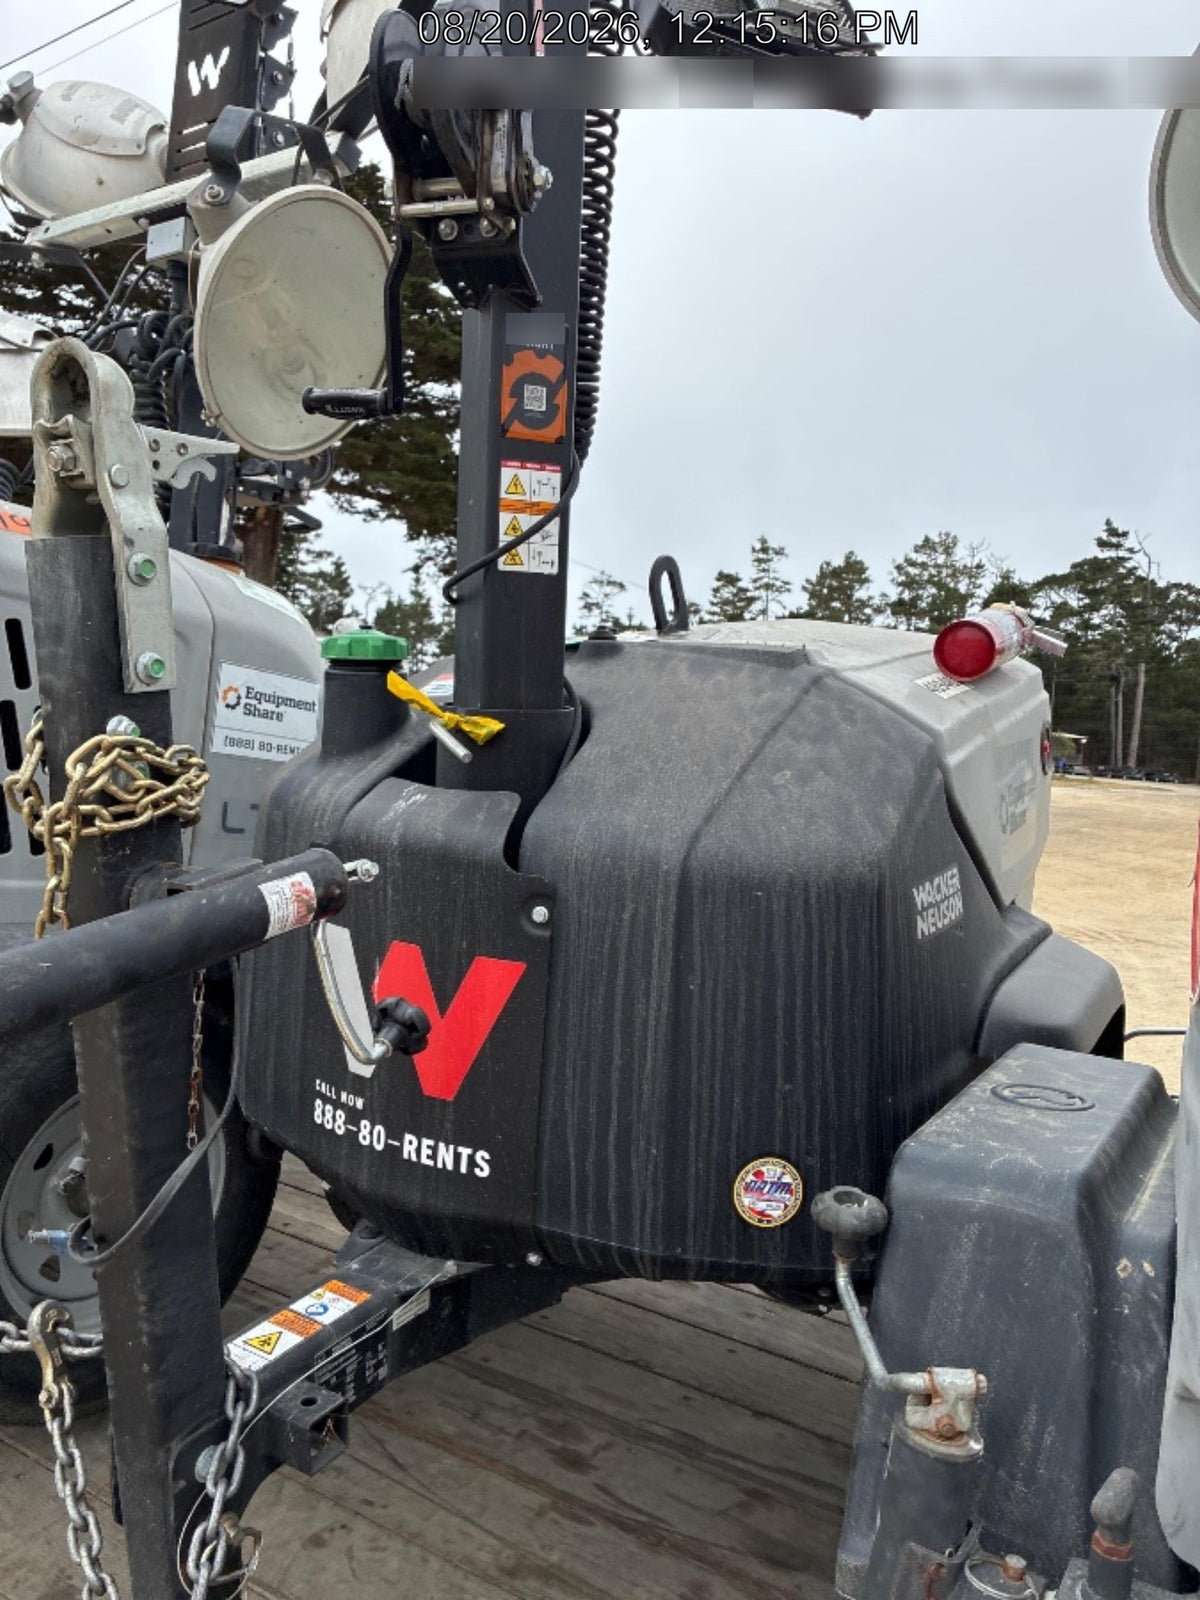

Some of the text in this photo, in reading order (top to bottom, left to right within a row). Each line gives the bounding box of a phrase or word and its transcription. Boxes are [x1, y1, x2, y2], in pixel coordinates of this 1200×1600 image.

[242, 702, 284, 723] Share
[244, 685, 317, 713] Equipment
[258, 740, 304, 756] 80-RENT
[912, 867, 961, 911] WACKER
[917, 891, 964, 940] NEUSON
[315, 1078, 365, 1110] CALL NOW
[313, 1098, 492, 1178] 888-80-RENTS
